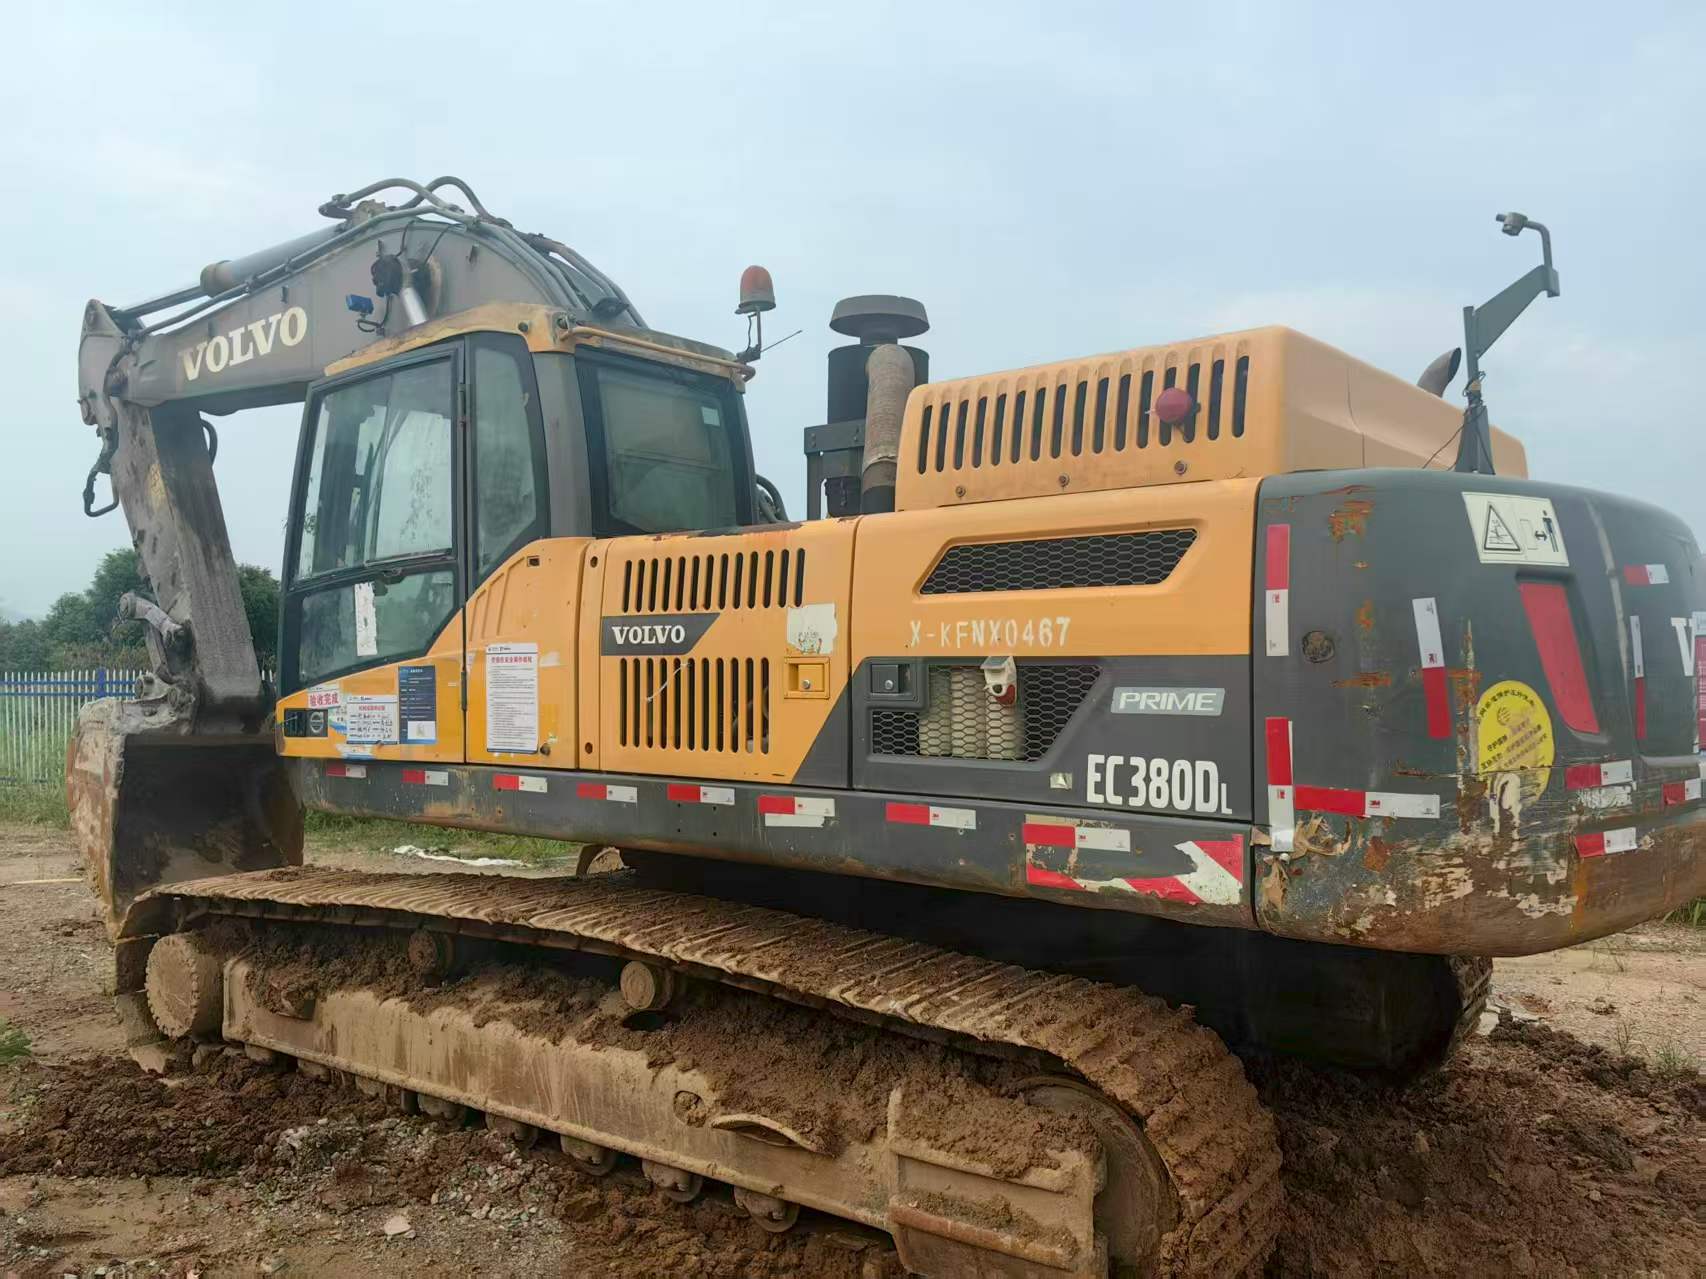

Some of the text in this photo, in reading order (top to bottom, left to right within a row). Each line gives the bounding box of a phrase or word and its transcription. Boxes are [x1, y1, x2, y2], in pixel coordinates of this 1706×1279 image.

[178, 307, 307, 380] VOLVO
[612, 625, 685, 644] VOLVO
[910, 616, 1071, 648] X-KFNX0467
[1119, 692, 1217, 711] PRIME
